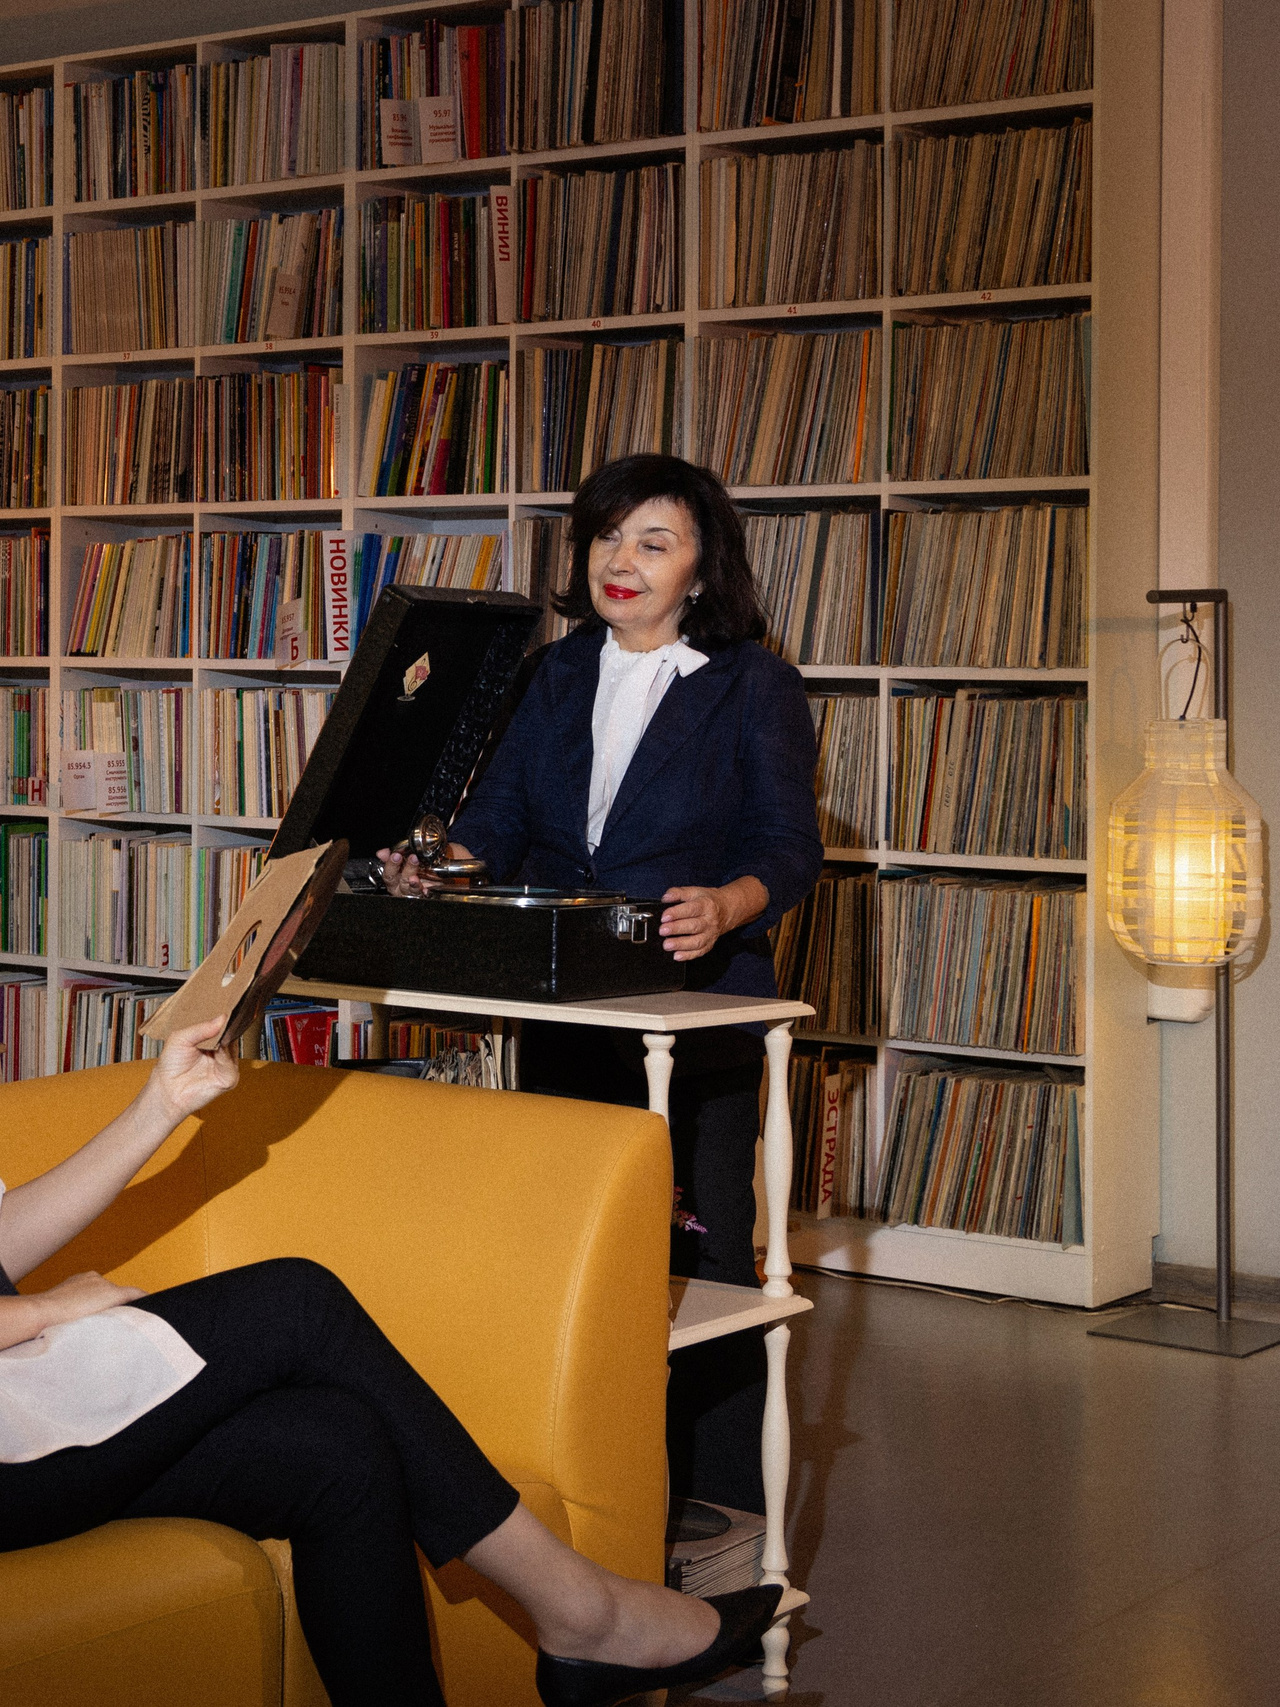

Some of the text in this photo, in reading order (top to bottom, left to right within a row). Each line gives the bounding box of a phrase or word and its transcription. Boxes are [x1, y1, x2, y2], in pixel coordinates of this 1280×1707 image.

[496, 195, 510, 262] ВИНИЛ
[980, 292, 992, 301] 42
[787, 306, 797, 314] 41
[591, 320, 601, 328] 40
[430, 331, 439, 339] 39
[265, 342, 273, 350] 38
[123, 352, 130, 360] 37
[329, 538, 350, 652] НОВИНКИ
[290, 636, 299, 661] Б
[67, 762, 92, 770] 85.954.3
[107, 759, 126, 768] 85.955
[30, 779, 42, 802] Н
[108, 786, 126, 794] 85.956
[162, 944, 169, 966] З
[821, 1087, 841, 1205] ЭСТРАДА
